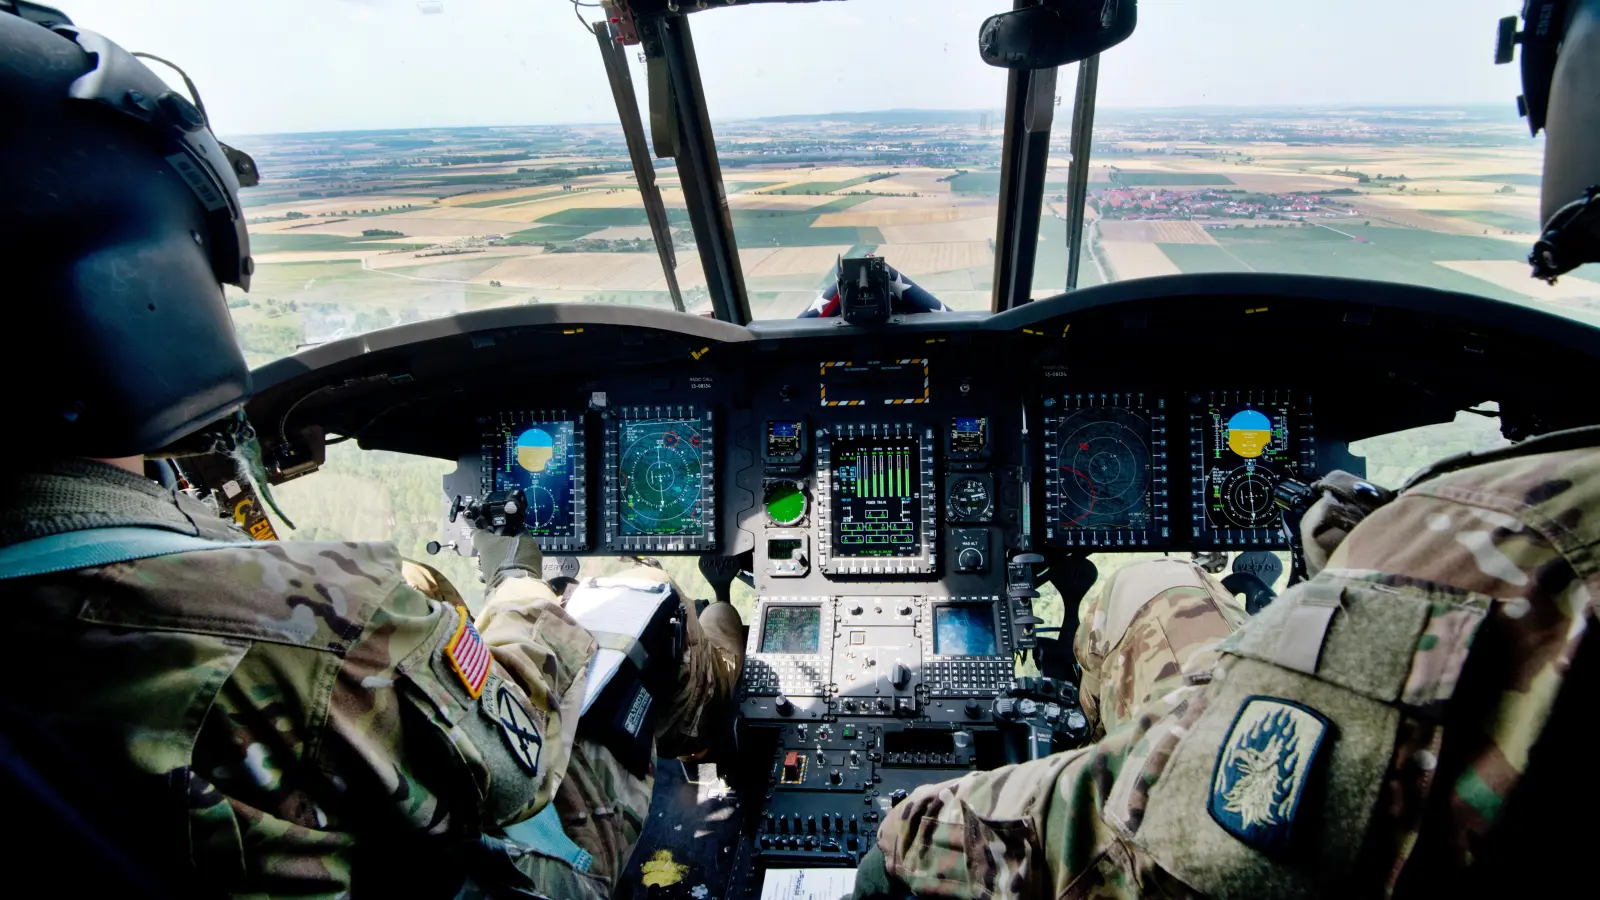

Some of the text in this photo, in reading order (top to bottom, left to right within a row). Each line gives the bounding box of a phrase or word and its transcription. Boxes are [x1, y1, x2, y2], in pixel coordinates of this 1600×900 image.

[543, 563, 576, 571] VERTOL
[1240, 563, 1279, 571] VERTOL
[629, 686, 648, 723] FLYBOYS
